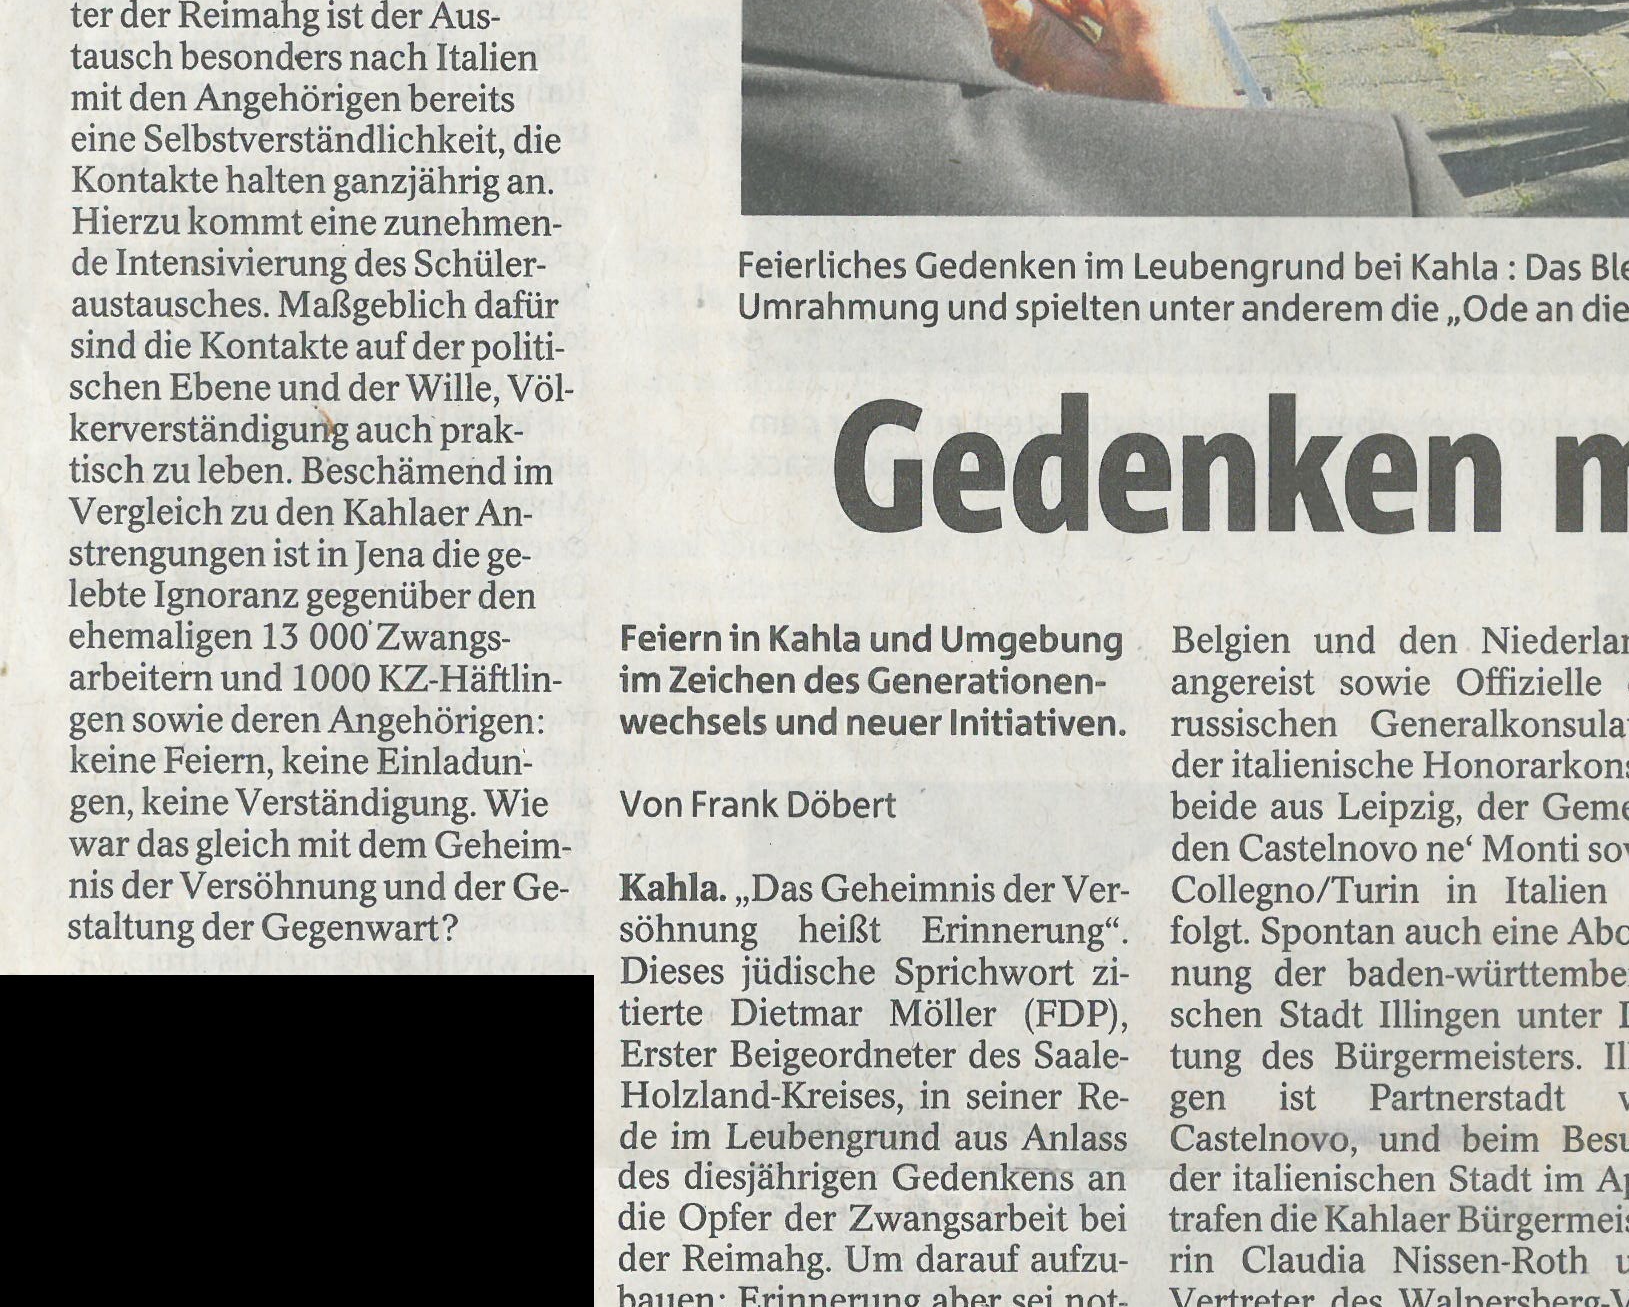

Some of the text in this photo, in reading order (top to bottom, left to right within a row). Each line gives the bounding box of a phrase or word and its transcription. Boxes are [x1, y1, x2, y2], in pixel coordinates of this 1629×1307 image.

[739, 249, 907, 280] Feierliches
[915, 250, 1076, 280] Gedenken
[1084, 251, 1124, 280] im
[1134, 250, 1345, 288] Leubengrund
[1354, 251, 1401, 281] bei
[1412, 251, 1498, 281] Kahla
[1526, 253, 1582, 282] Das
[833, 392, 1502, 535] Gedenken
[68, 619, 511, 660] ehemaligen 13 000 Zwangs-
[621, 622, 1123, 662] Feiern in Kahla und Umgebung
[619, 788, 897, 819] Von Frank Döbert
[1171, 873, 1420, 912] Collegno/Turin
[1446, 874, 1478, 904] in
[1505, 874, 1608, 905] Italien
[67, 910, 459, 950] staltung der Gegenwart?
[618, 996, 1128, 1036] tierte Dietmar Möller (FDP),
